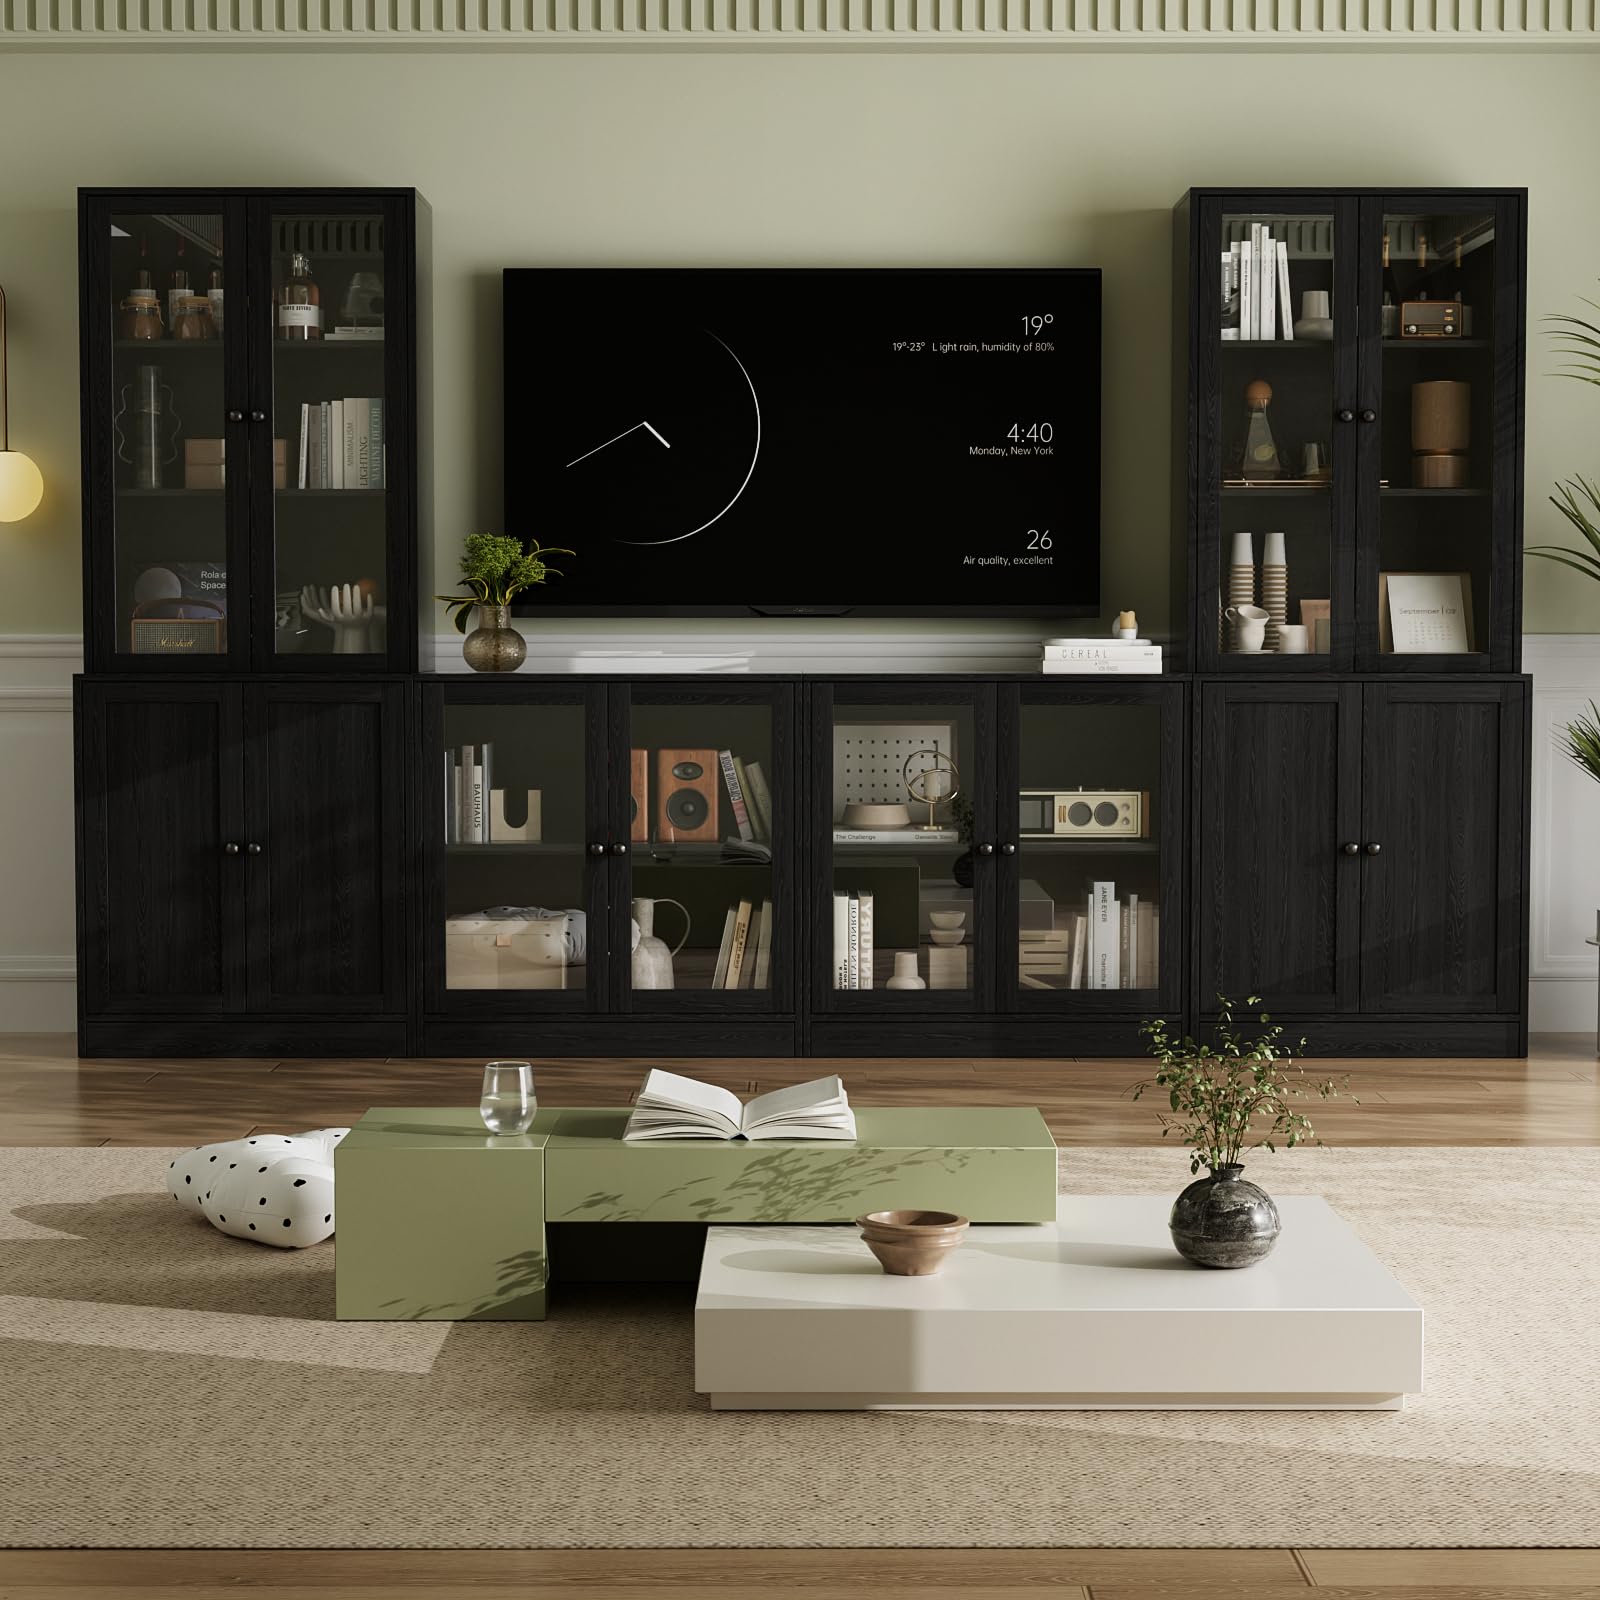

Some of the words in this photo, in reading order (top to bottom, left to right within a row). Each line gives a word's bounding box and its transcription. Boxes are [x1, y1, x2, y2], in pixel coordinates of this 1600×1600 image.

[1021, 313, 1054, 336] 19°
[959, 342, 979, 353] rain,
[981, 342, 1021, 353] humidity
[1023, 342, 1033, 352] of
[1035, 342, 1055, 352] 80%
[371, 407, 381, 440] DECOR
[1006, 422, 1053, 443] 4:40
[969, 446, 1008, 457] Monday,
[1010, 446, 1031, 455] New
[1033, 446, 1054, 455] York
[359, 436, 368, 486] LIGHTING
[371, 443, 381, 481] MARINE
[1026, 529, 1053, 550] 26
[963, 555, 976, 565] Air
[977, 555, 1011, 567] quality,
[1013, 555, 1054, 565] excellent
[201, 571, 219, 579] Rola
[201, 582, 226, 590] Space
[1062, 649, 1108, 659] CEREAL
